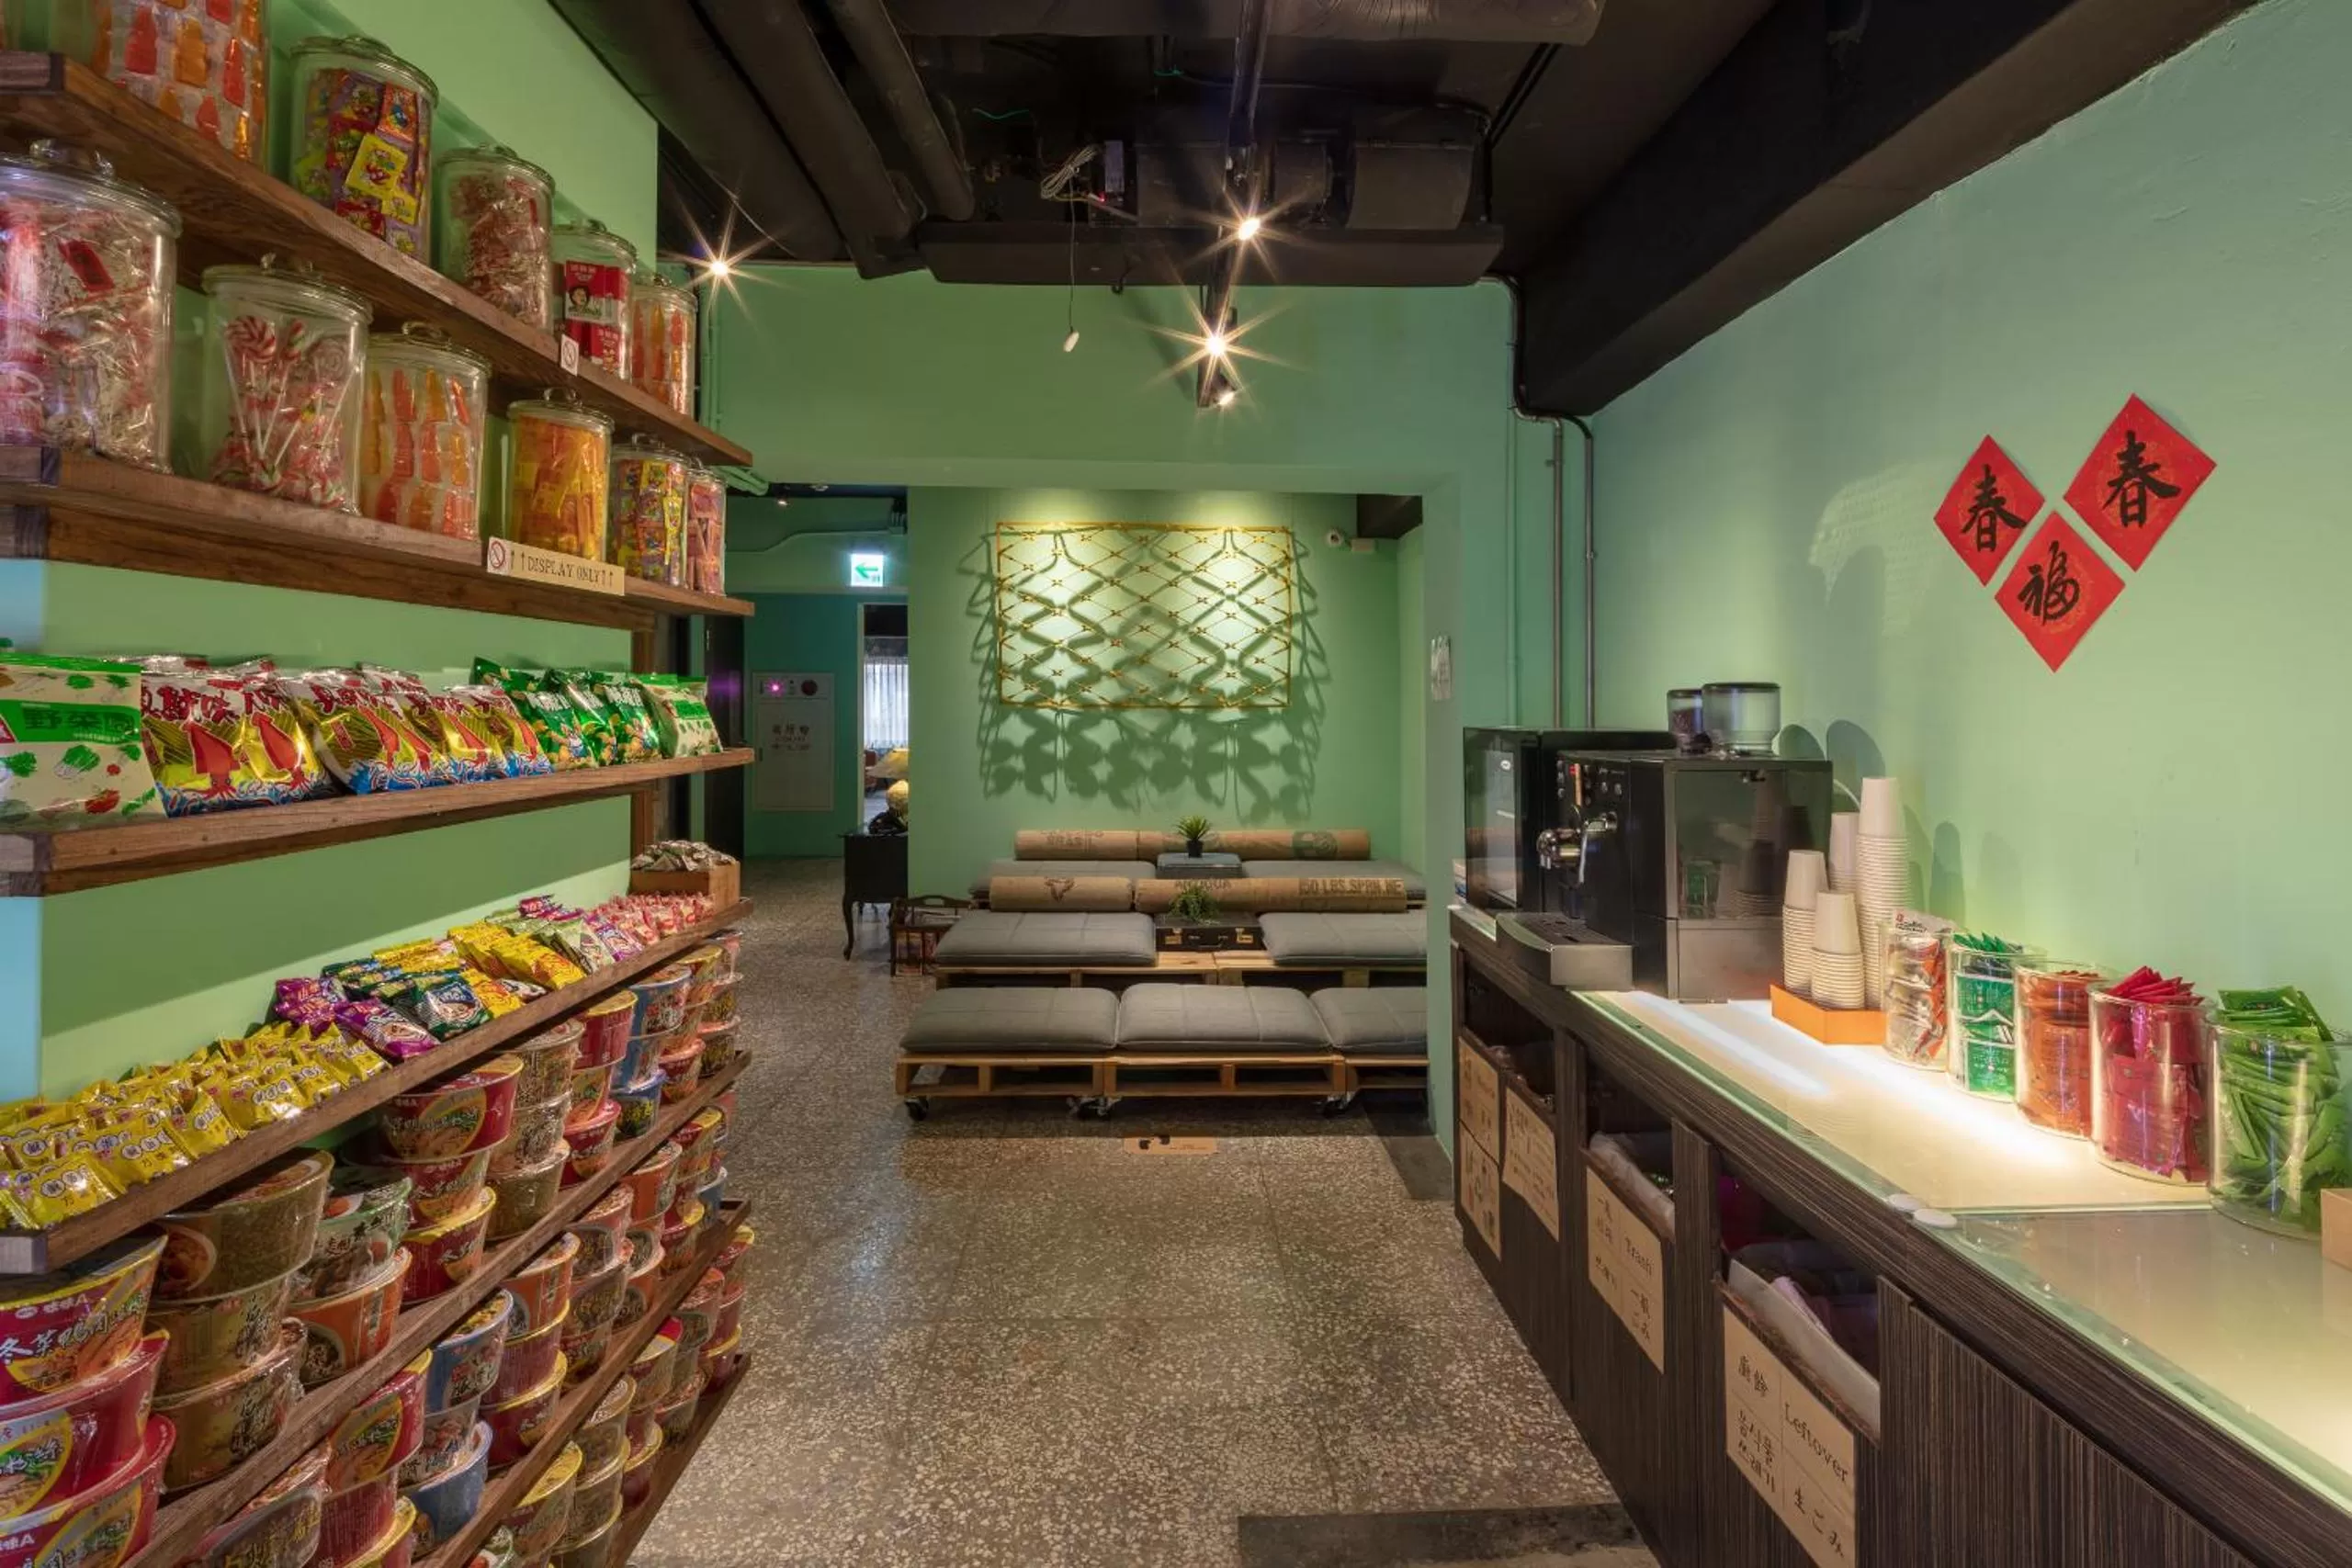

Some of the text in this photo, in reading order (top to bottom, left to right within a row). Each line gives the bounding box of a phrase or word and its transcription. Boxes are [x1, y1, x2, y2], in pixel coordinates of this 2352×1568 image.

[1961, 463, 2028, 552] 春
[2102, 429, 2183, 529] 春
[527, 555, 600, 583] DISPLAY ONLY
[2017, 539, 2081, 626] 福
[1784, 1401, 1849, 1482] Leftover
